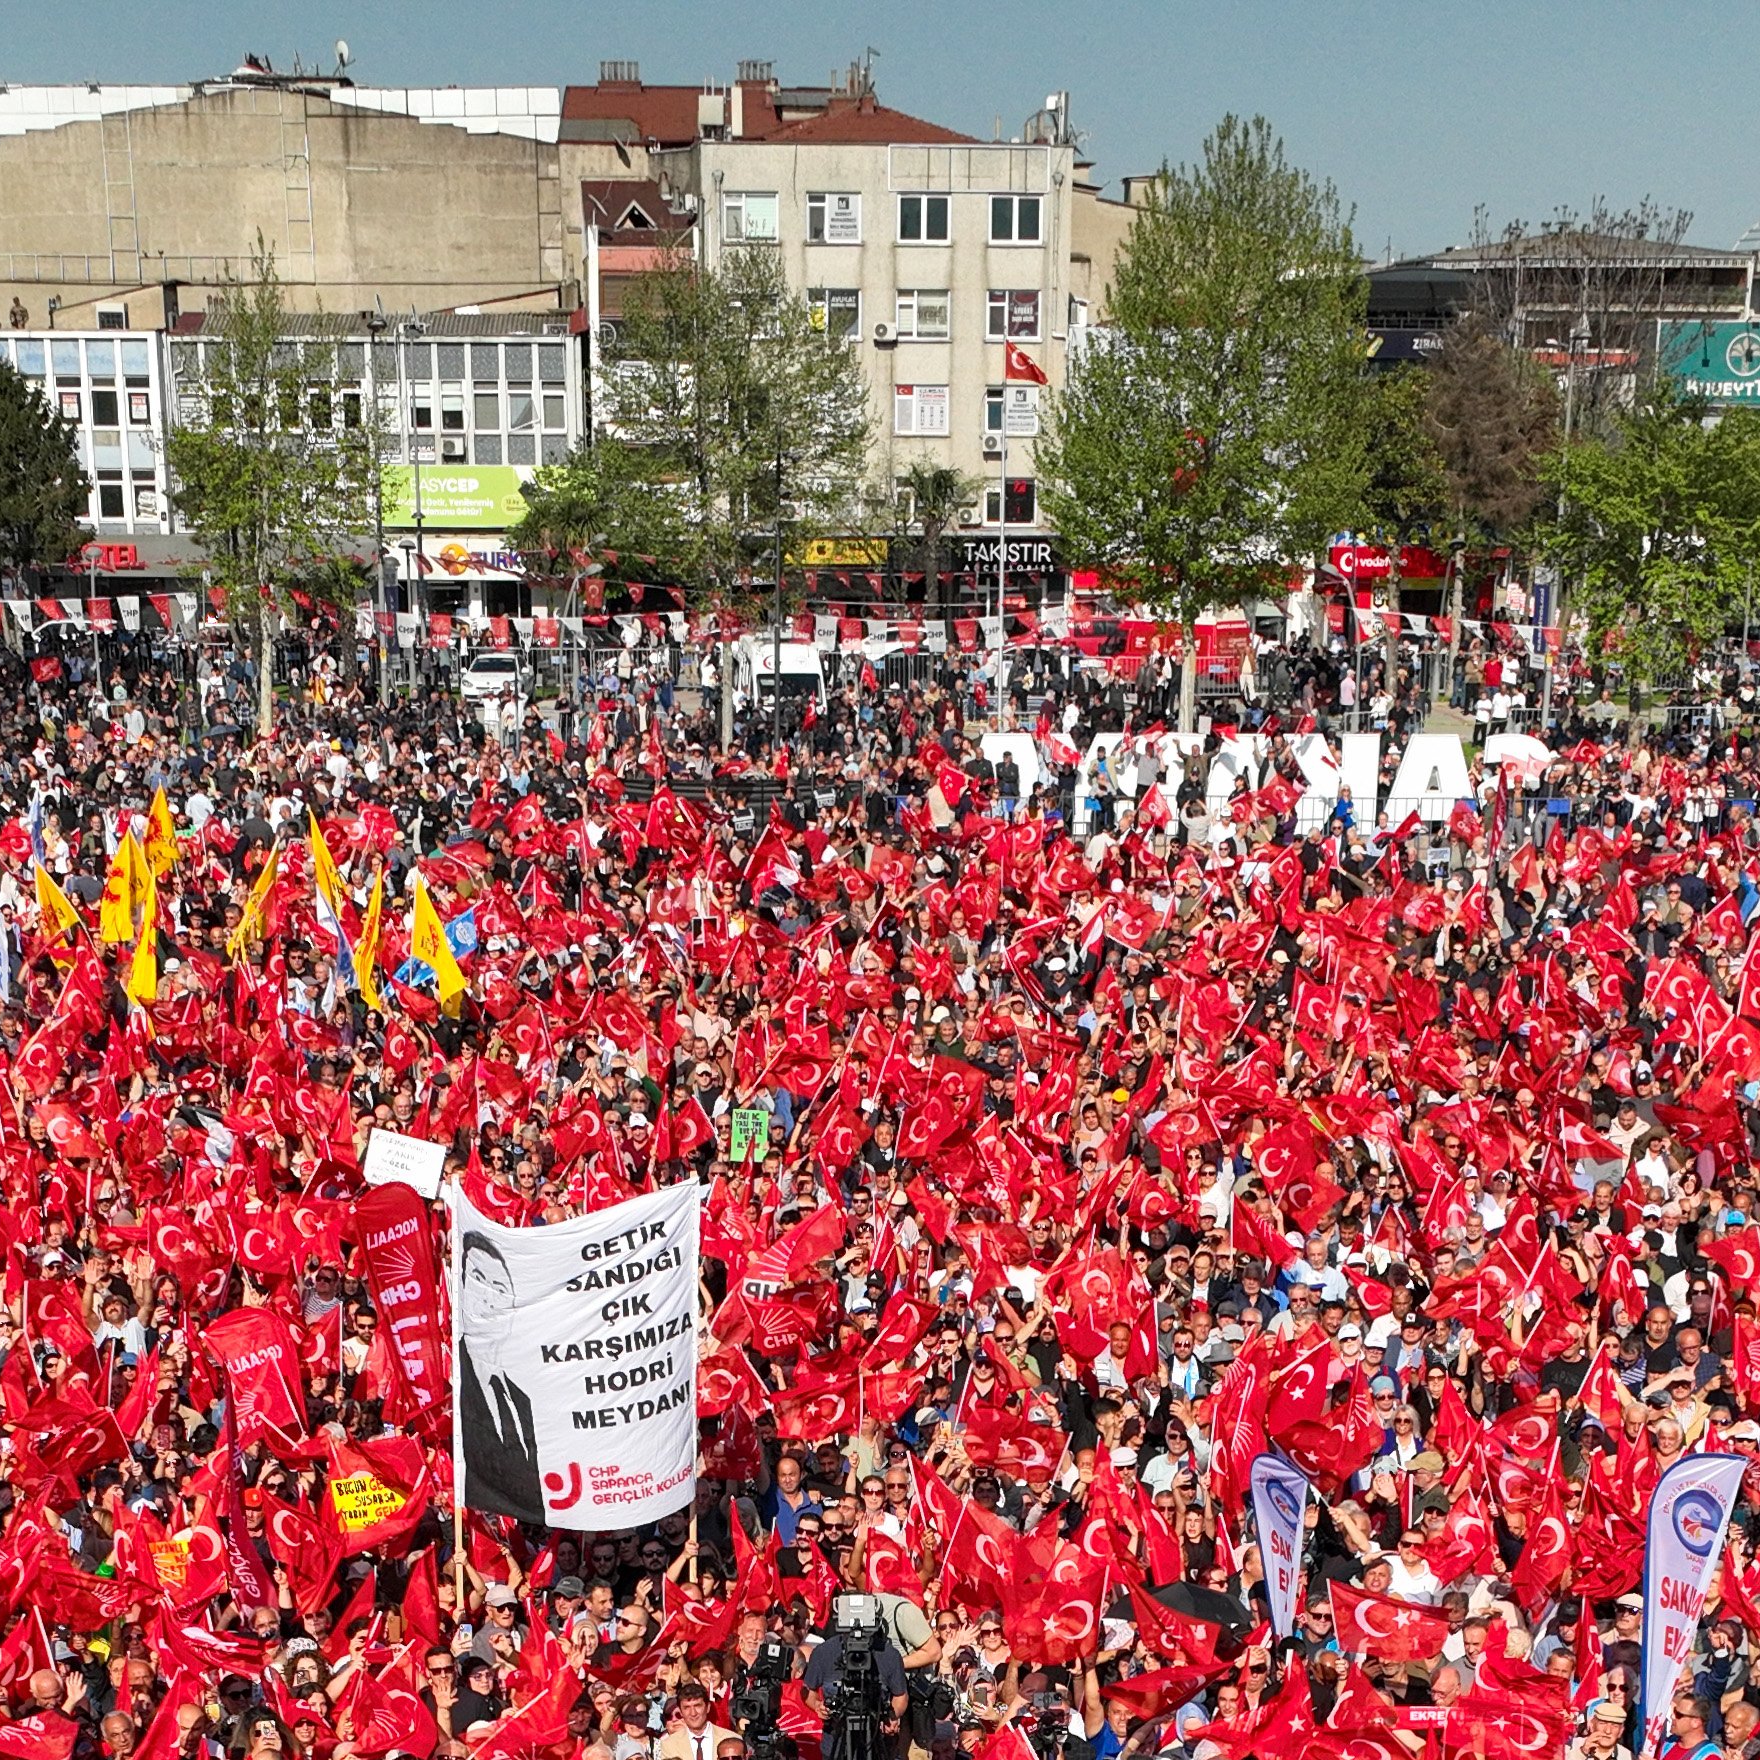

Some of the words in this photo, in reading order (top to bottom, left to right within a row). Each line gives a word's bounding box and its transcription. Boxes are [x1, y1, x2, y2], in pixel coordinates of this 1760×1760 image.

[581, 1220, 667, 1264] GETİR
[566, 1246, 681, 1293] SANDIĞI
[601, 1292, 653, 1328] ÇIK
[540, 1311, 693, 1367] KARŞIMIZA
[585, 1353, 674, 1396] HODRİ
[588, 1465, 620, 1478] CHP
[592, 1472, 654, 1492] SAPANCA
[592, 1484, 654, 1506] GENÇLİK
